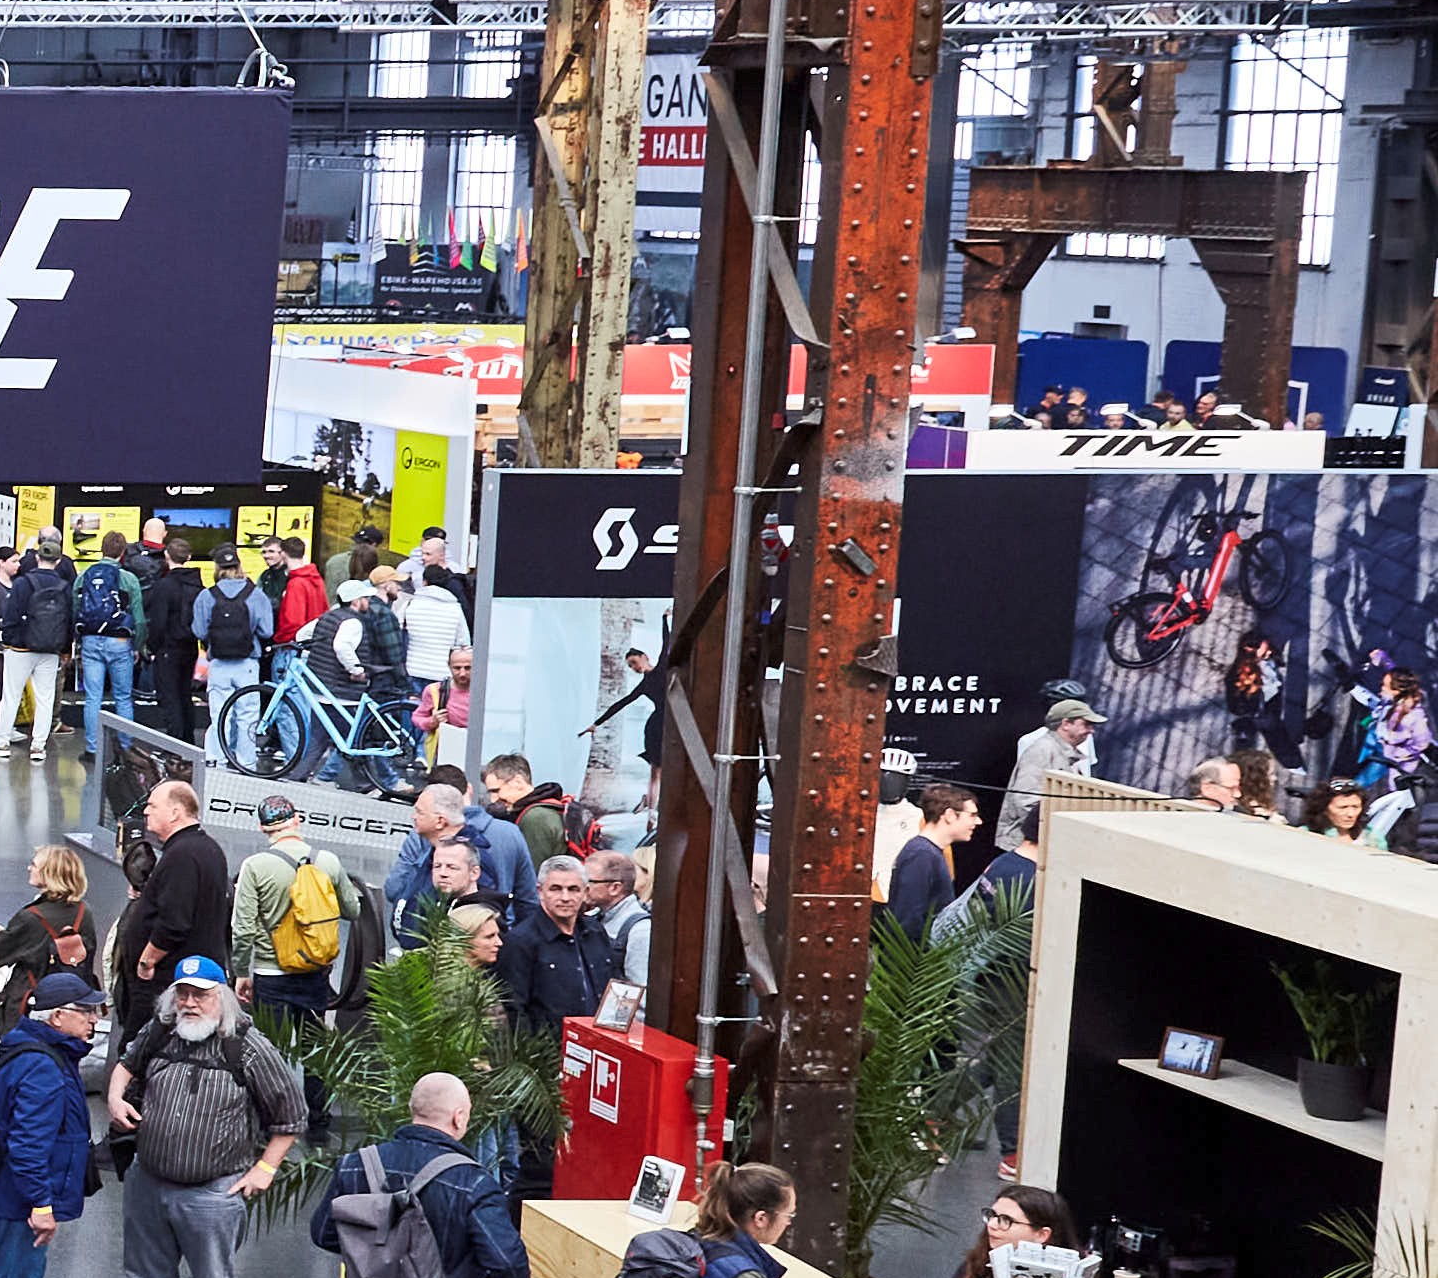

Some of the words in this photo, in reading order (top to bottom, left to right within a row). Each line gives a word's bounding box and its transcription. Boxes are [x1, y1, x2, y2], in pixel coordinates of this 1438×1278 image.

[652, 133, 706, 160] HALL
[1058, 435, 1242, 457] TIME
[413, 457, 441, 469] ERGON
[894, 675, 979, 692] BRACE
[885, 697, 1002, 714] VEMENT
[209, 797, 414, 836] DRSSIGER
